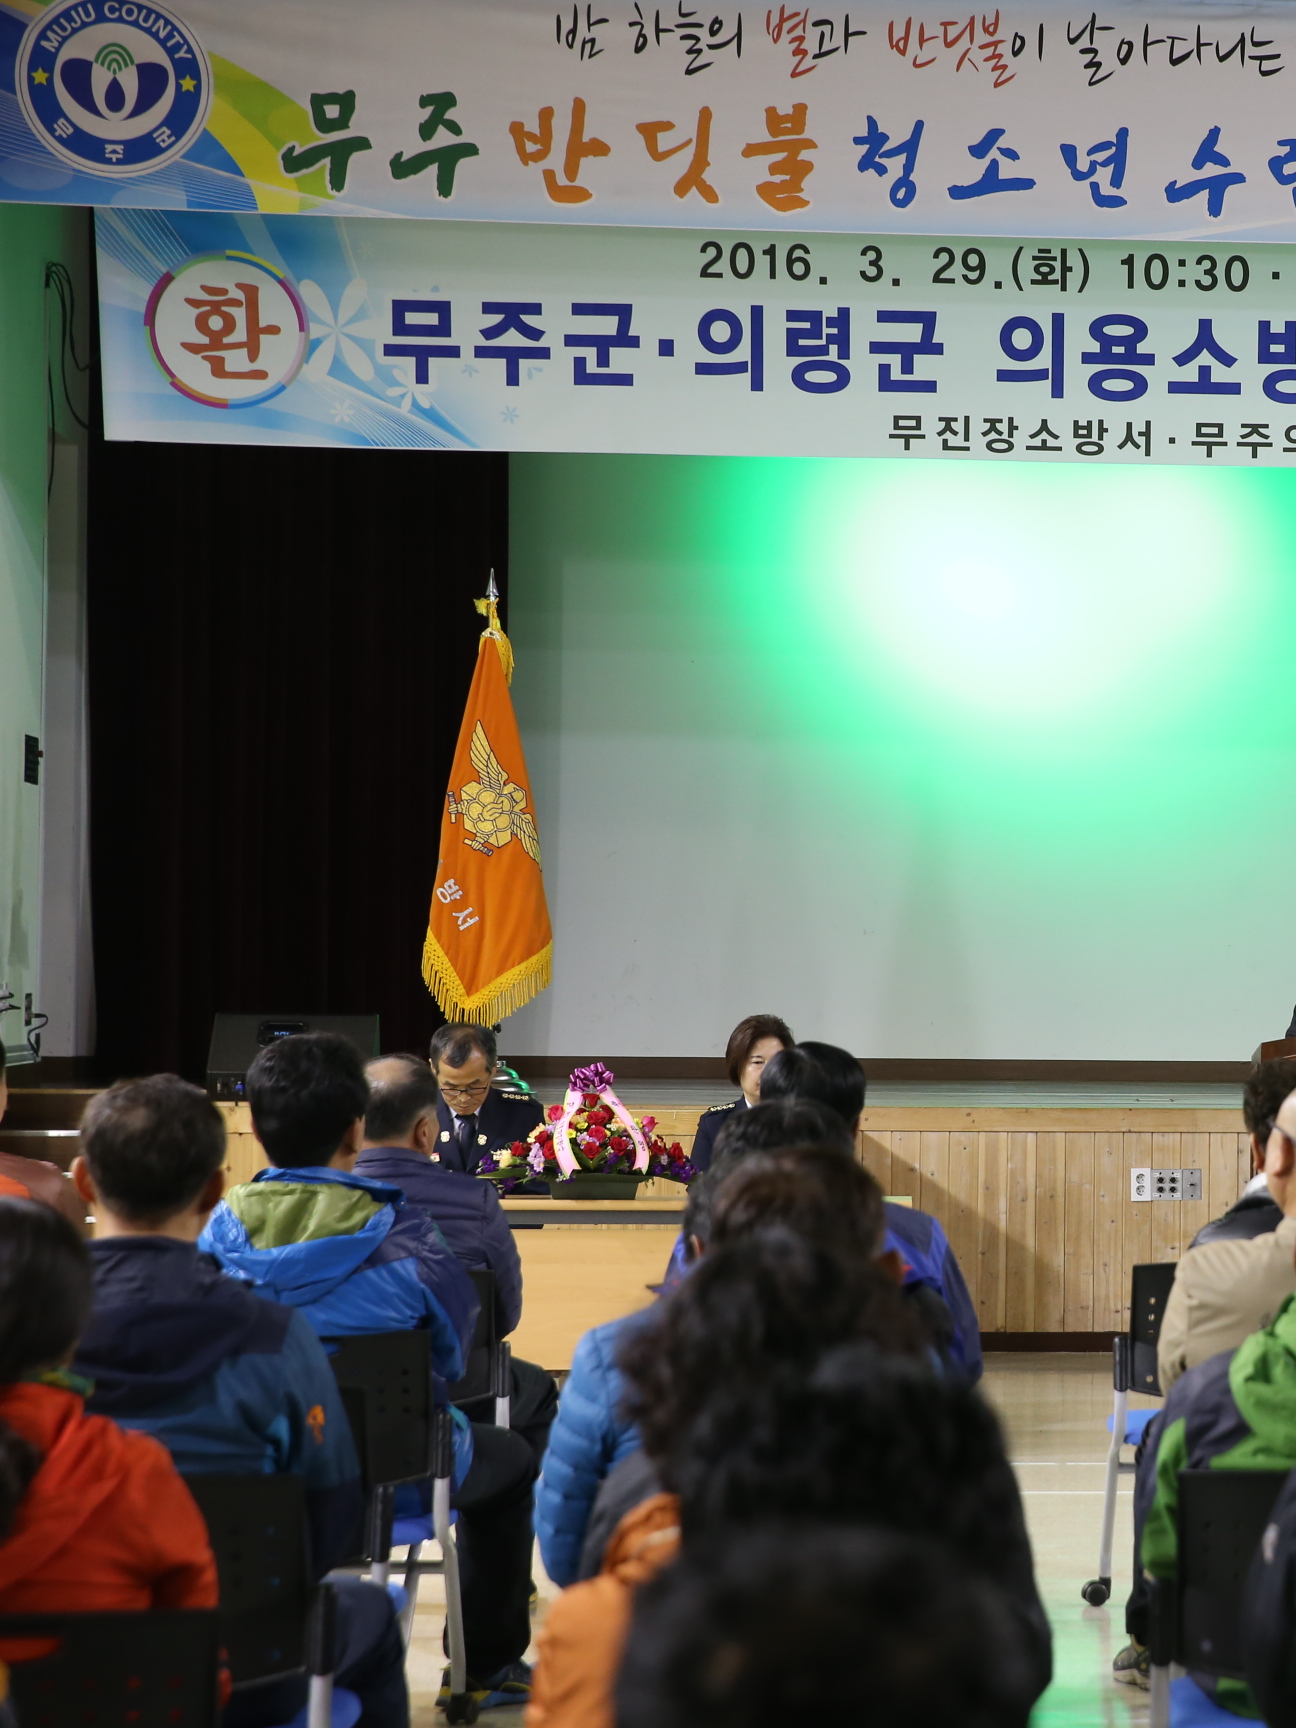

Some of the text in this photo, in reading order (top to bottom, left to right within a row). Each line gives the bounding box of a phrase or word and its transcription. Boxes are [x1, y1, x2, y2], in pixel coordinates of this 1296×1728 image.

[40, 2, 192, 60] MUJU COUNTY
[556, 3, 610, 61] 밤
[628, 0, 743, 76] 하늘의
[766, 4, 868, 78] 별과
[888, 9, 1043, 88] 반딧불이
[1066, 12, 1285, 86] 날아다니는
[54, 117, 176, 163] 무주군
[281, 89, 479, 199] 무주
[509, 96, 818, 213] 반딧불
[699, 241, 828, 286] 2016.
[860, 244, 901, 287] 3.
[932, 246, 1090, 294] 29.(화)
[1120, 252, 1250, 293] 10:30
[180, 282, 282, 381] 환
[382, 298, 944, 396] 무주군·의령군
[436, 878, 480, 931] 방서
